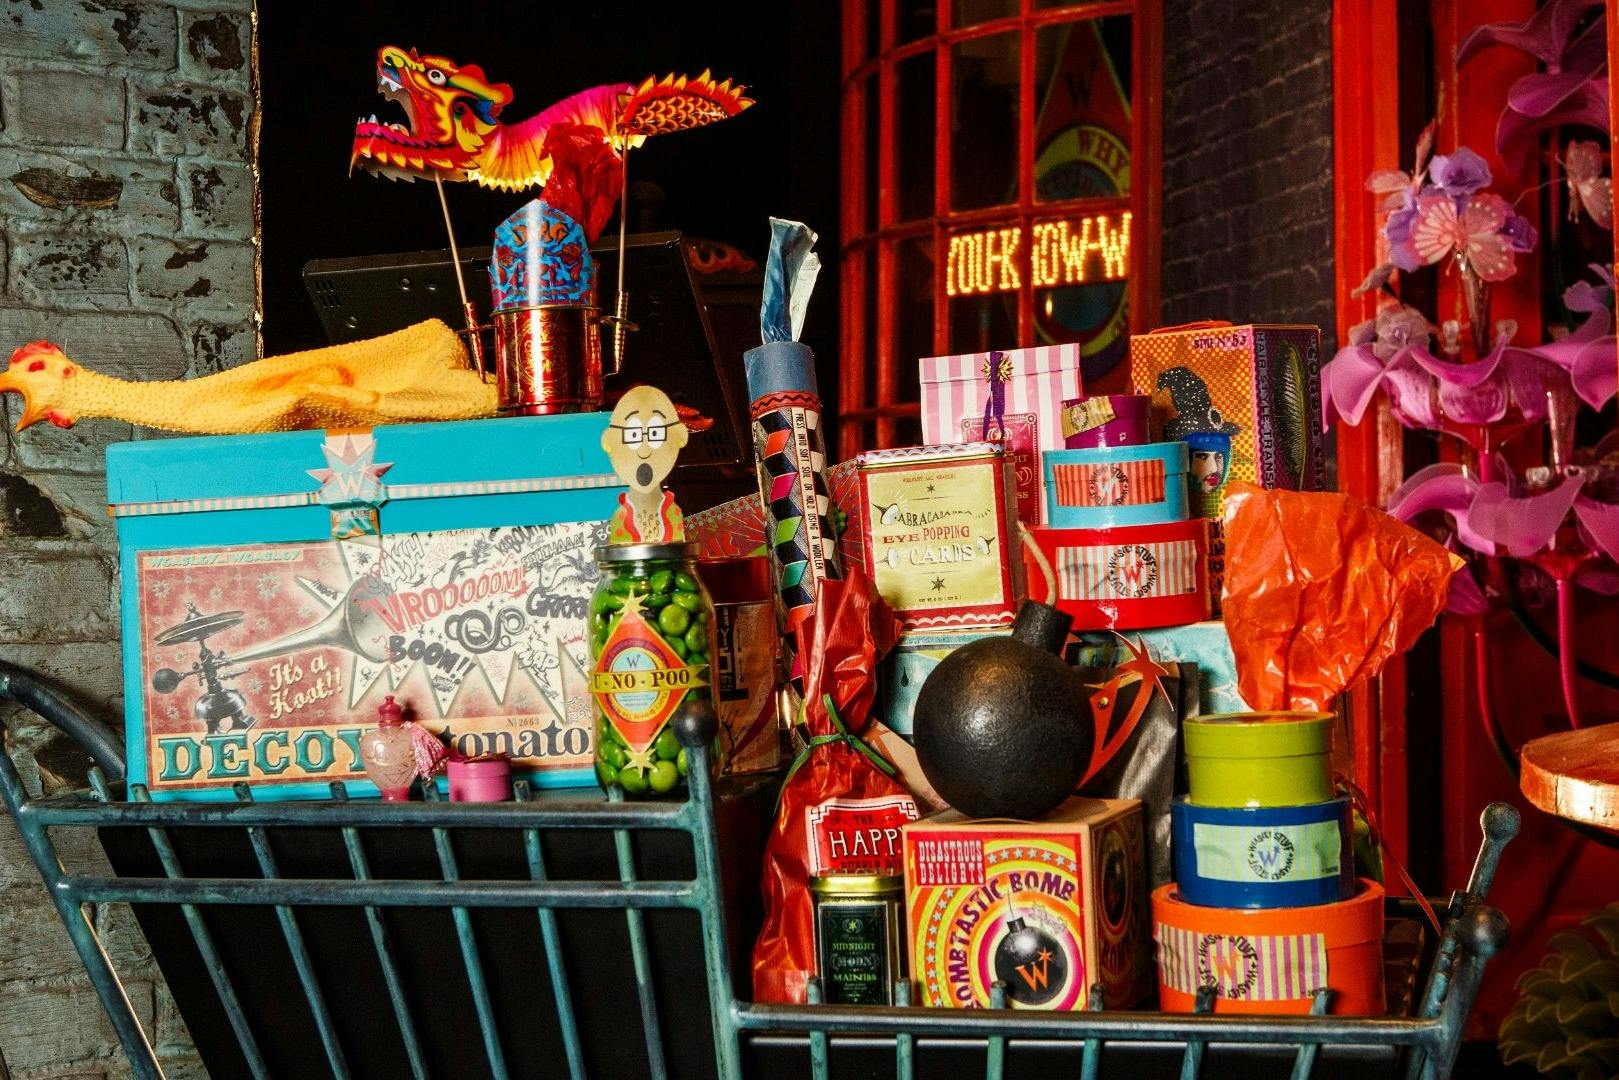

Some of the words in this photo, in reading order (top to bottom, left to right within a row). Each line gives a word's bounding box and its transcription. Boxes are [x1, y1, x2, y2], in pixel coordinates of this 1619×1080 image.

[1193, 338, 1213, 349] STYLE
[1257, 332, 1267, 369] HAIR
[1259, 376, 1270, 422] STYLE
[795, 413, 805, 430] PRESS
[798, 432, 808, 447] INTO
[800, 448, 810, 463] SOFT
[334, 467, 368, 498] W
[802, 466, 811, 479] SOIL
[804, 483, 813, 491] OR
[805, 495, 815, 510] HOLD
[807, 513, 818, 531] USING
[883, 533, 920, 544] EYE
[923, 525, 970, 541] POPPING
[811, 543, 823, 570] WOOLLEN
[909, 544, 975, 566] CARDS
[1121, 560, 1144, 583] W
[519, 650, 559, 671] ZAP
[626, 654, 641, 668] W
[269, 656, 304, 691] It's
[311, 655, 329, 672] a
[611, 673, 636, 690] NO
[651, 669, 690, 688] POO
[829, 827, 904, 858] HAPP
[918, 840, 982, 863] DISASTROUS
[1257, 845, 1280, 867] W
[920, 862, 984, 884] DELIGHTS
[1008, 871, 1075, 901] BOMB
[1015, 950, 1051, 992] W
[1212, 949, 1241, 979] W
